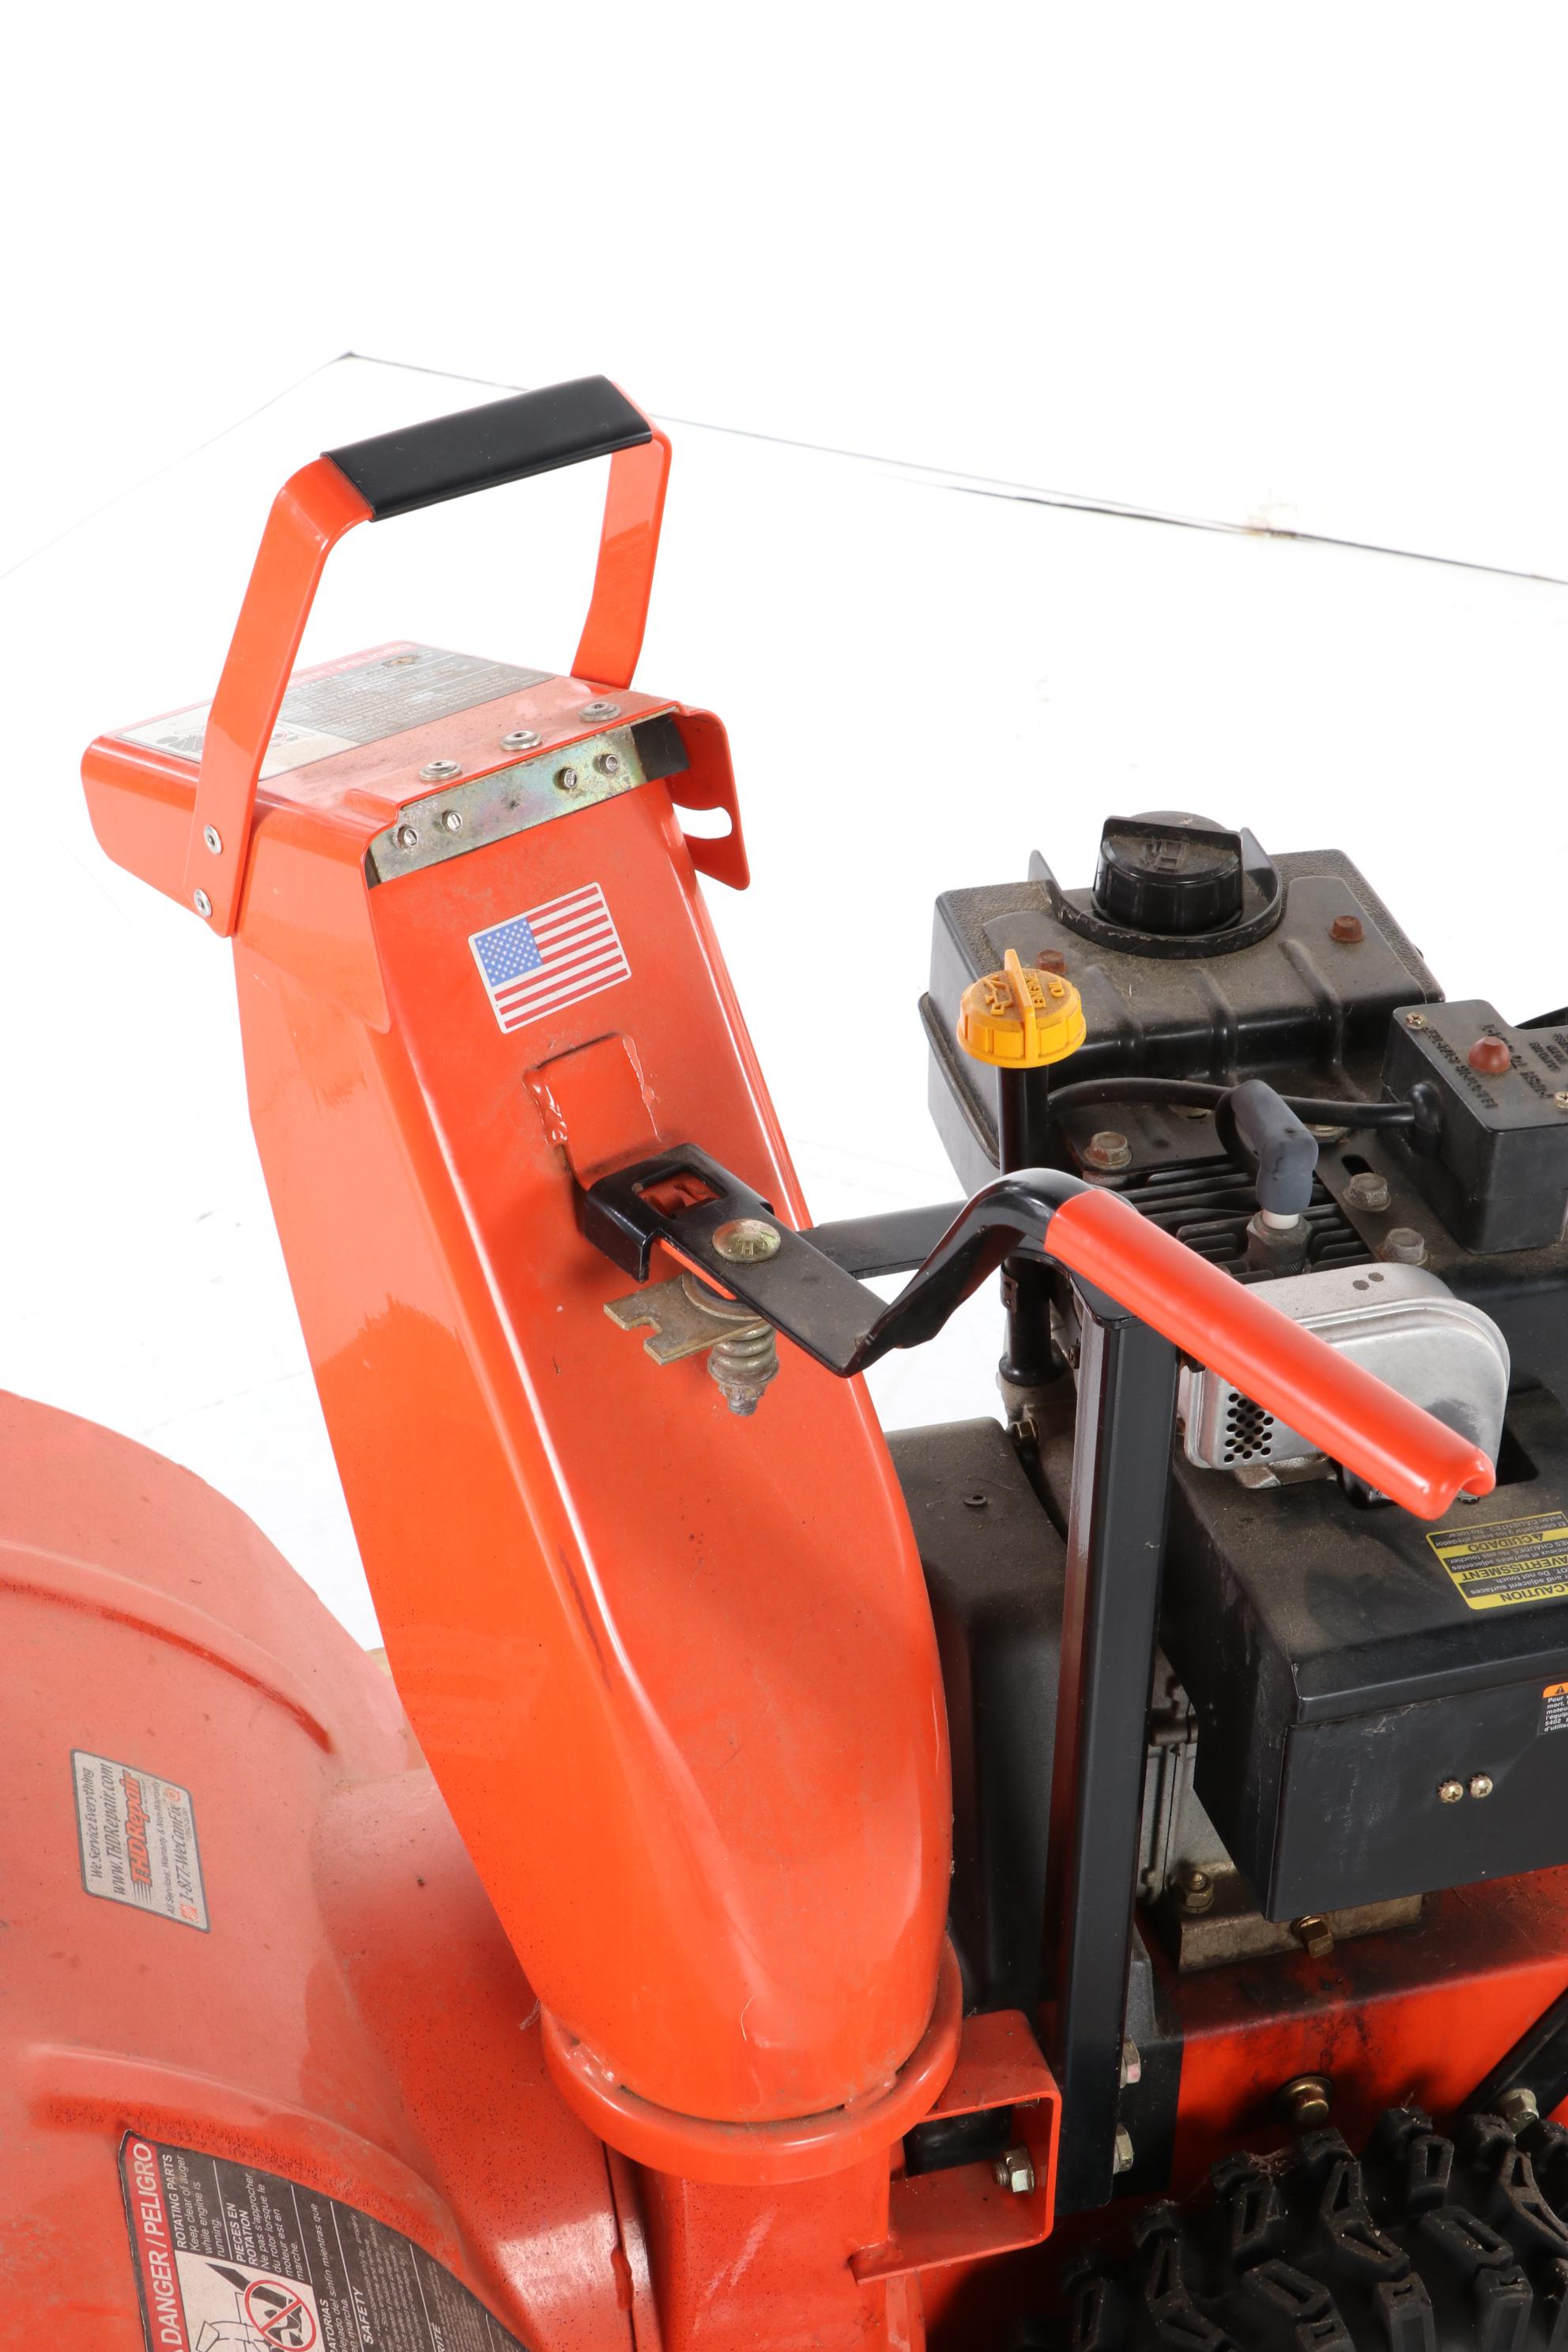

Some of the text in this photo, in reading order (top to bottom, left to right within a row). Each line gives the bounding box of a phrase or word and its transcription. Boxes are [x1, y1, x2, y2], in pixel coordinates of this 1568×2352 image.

[1468, 1535, 1532, 1551] CUIDADO
[1451, 1559, 1494, 1570] adjacentes
[1463, 1555, 1568, 1581] AVERTISSMENT
[1508, 1578, 1544, 1589] adjacent
[1470, 1585, 1507, 1594] surfaces
[1500, 1584, 1565, 1601] CAUTION
[1545, 1718, 1562, 1727] 5402
[81, 1767, 103, 1878] We Service Everything
[100, 1764, 125, 1894] www.THDRepair.com
[132, 2143, 165, 2237] PELIGRO
[162, 2154, 187, 2248] ROTATING PARTS
[176, 2154, 199, 2251] Keep clear of auger
[194, 2192, 208, 2226] engine
[226, 2202, 246, 2262] PIECES EN
[244, 2173, 270, 2269] Ne pas s'approcher
[256, 2184, 281, 2273] du rotor lorsque le
[310, 2203, 321, 2222] que
[200, 2228, 213, 2253] while
[211, 2218, 224, 2257] running.
[239, 2210, 258, 2265] ROTATION
[273, 2208, 292, 2276] moteur est en
[315, 2224, 329, 2267] mientras
[148, 2250, 183, 2346] DANGER
[330, 2297, 340, 2315] del
[341, 2297, 355, 2338] marcha.
[352, 2286, 373, 2344] SAFETY
